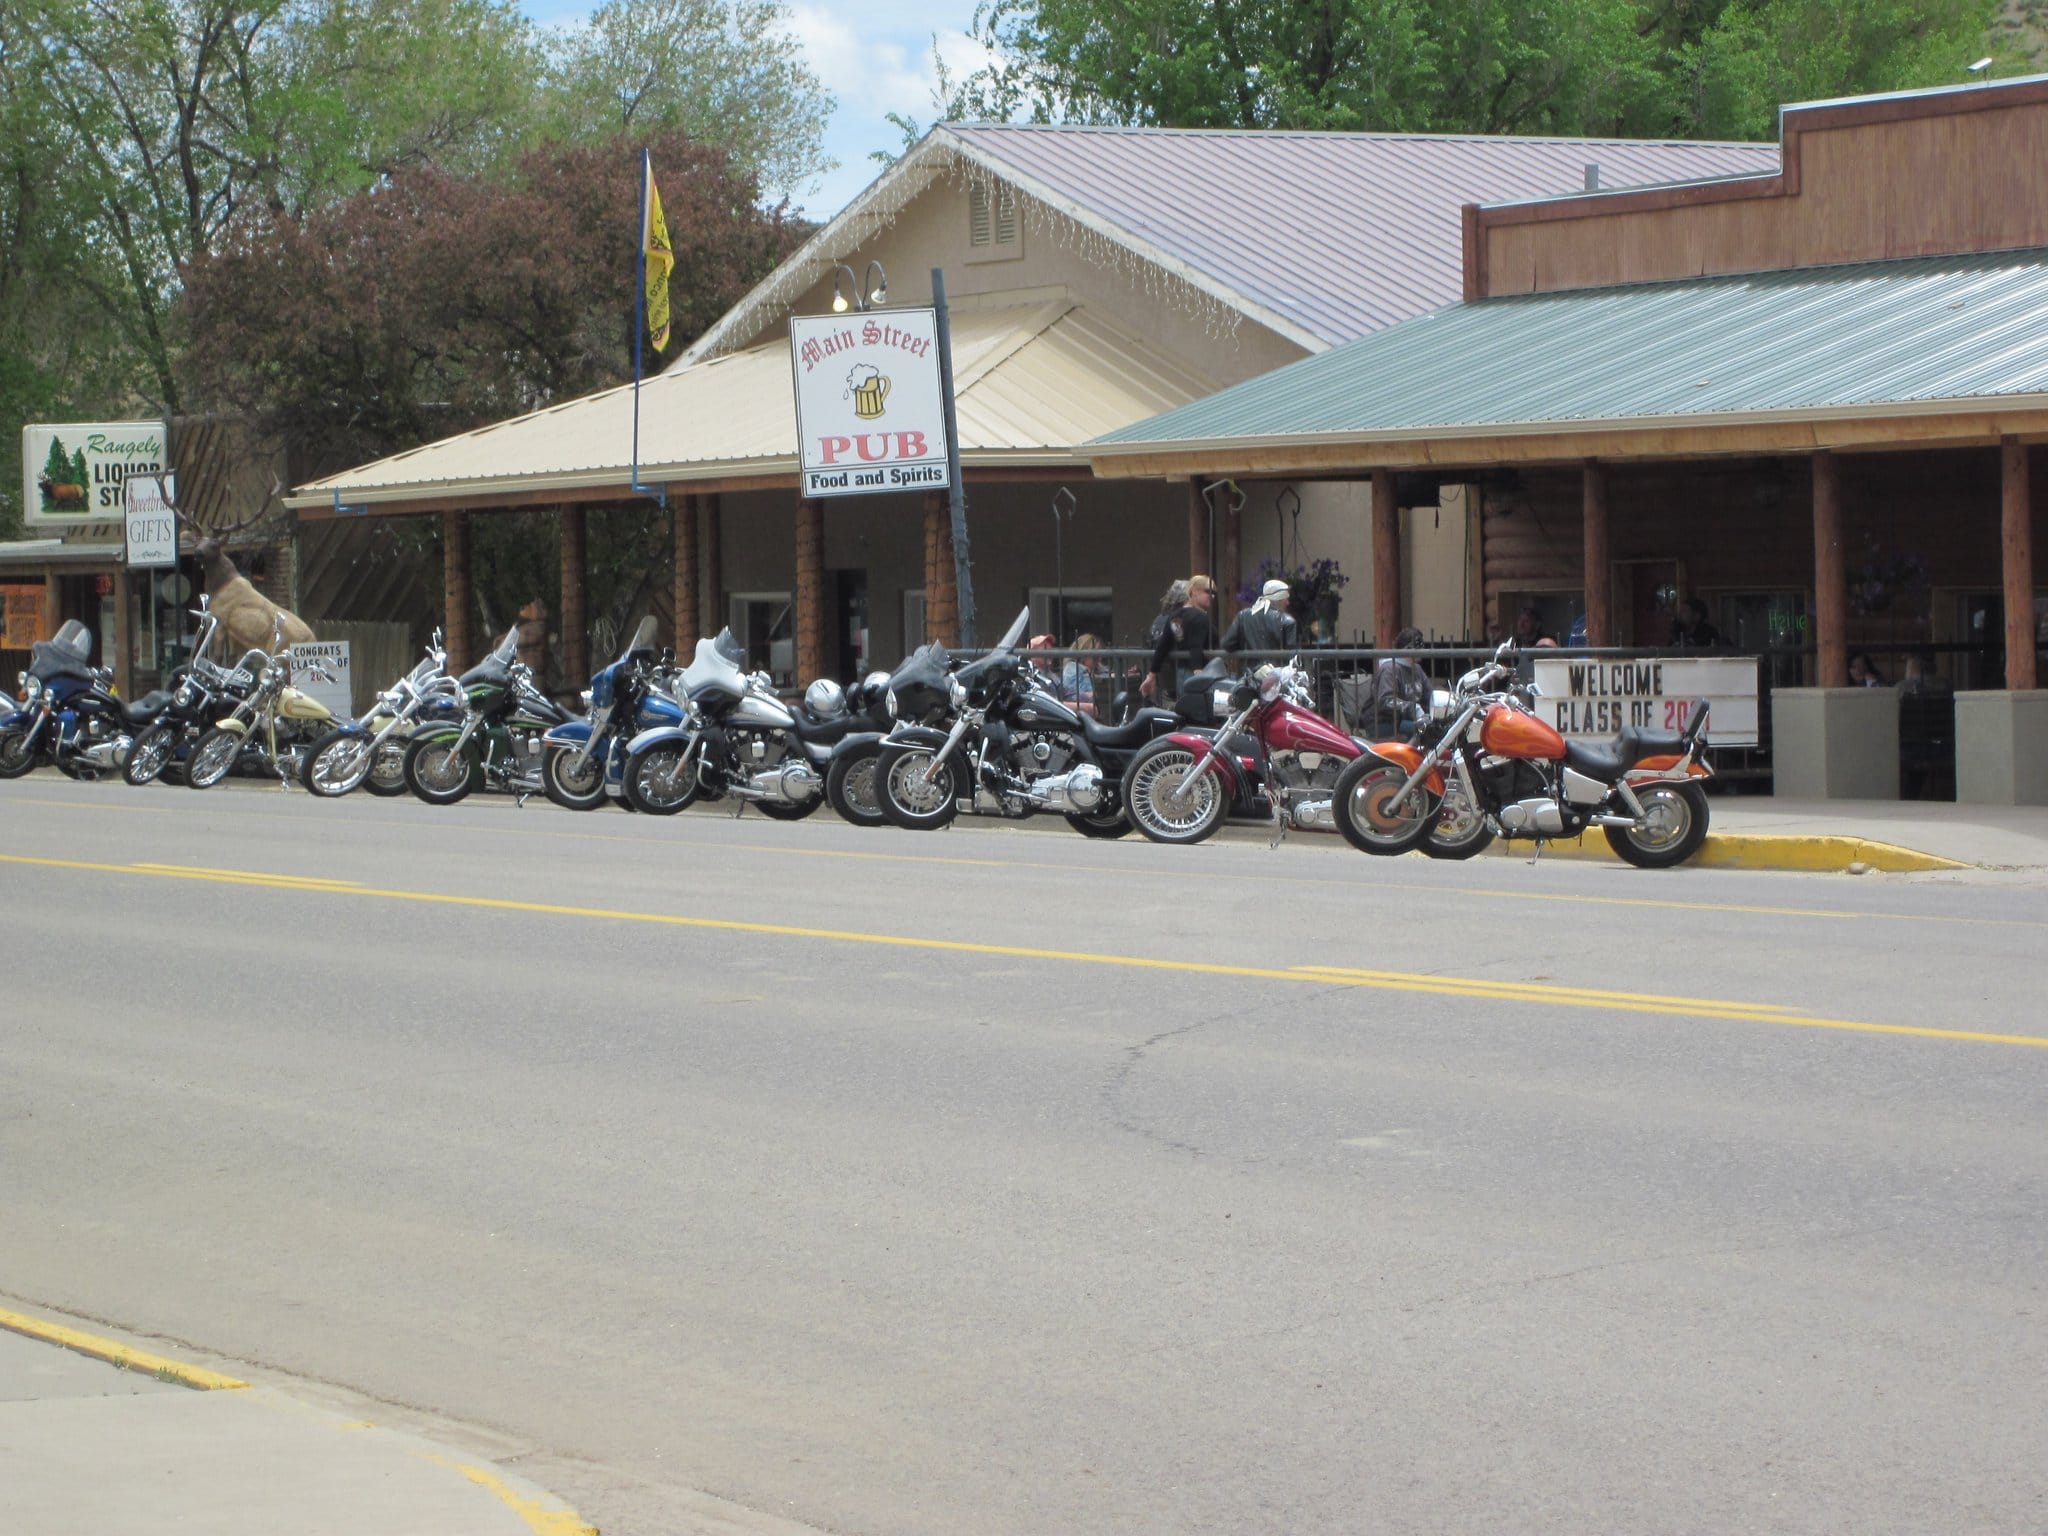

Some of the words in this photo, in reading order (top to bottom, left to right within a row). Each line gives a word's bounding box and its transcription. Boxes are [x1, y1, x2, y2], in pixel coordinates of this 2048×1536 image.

[801, 329, 855, 373] Main
[862, 319, 931, 358] Street
[87, 433, 160, 460] Rangely
[818, 430, 928, 465] PUB
[810, 472, 848, 489] Food
[855, 470, 885, 486] and
[890, 466, 943, 486] Spirits
[129, 519, 171, 544] GIFTS
[291, 659, 320, 670] CLASS
[337, 657, 348, 668] OF
[294, 645, 341, 658] CONGRATS
[1568, 663, 1663, 697] WELCOME
[1556, 700, 1622, 734] CLASS
[1631, 701, 1653, 728] OF
